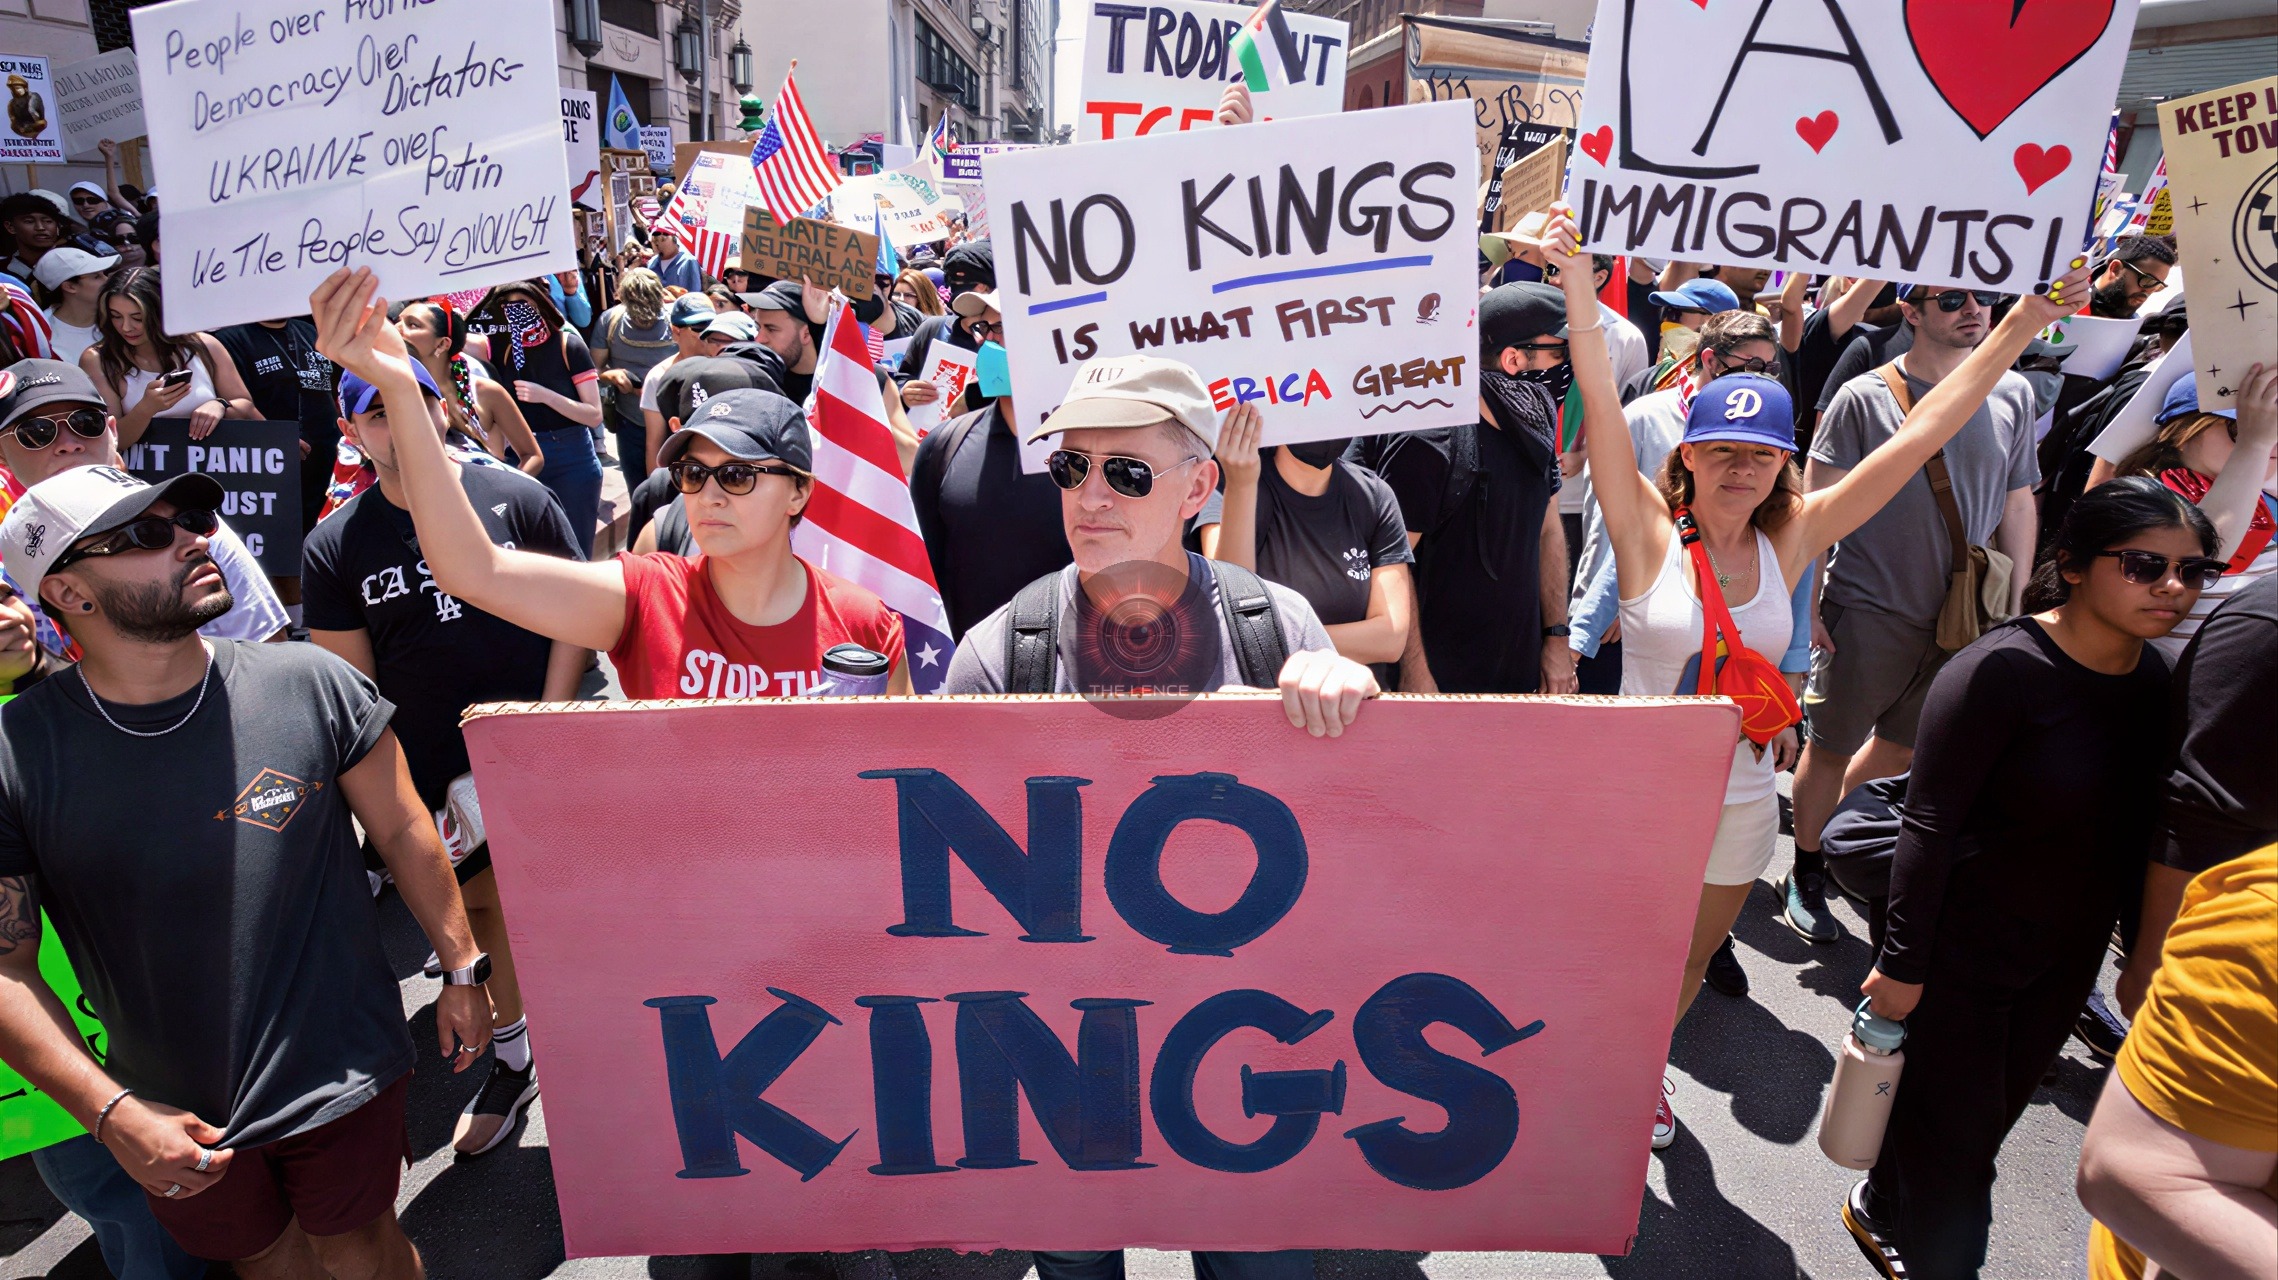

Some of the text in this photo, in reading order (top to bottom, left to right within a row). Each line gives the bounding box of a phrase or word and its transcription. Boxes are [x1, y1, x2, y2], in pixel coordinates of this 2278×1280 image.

[166, 12, 255, 75] People
[270, 10, 325, 43] over
[1094, 3, 1246, 84] TROOP
[2175, 91, 2257, 136] KEEP
[210, 125, 447, 203] UKRAINE over
[298, 209, 389, 268] People
[391, 205, 445, 263] Say
[844, 232, 863, 257] A
[1011, 193, 1136, 296] NO
[1181, 160, 1456, 271] KINGS
[1580, 178, 2063, 295] IMMIGRANTS!
[1052, 296, 1396, 364] IS WHAT FIRST
[1207, 355, 1466, 412] ERICA GREAT
[1724, 388, 1762, 420] D
[187, 445, 285, 475] PANIC
[221, 490, 277, 516] UST
[680, 649, 769, 698] STOP
[858, 767, 1309, 956] NO
[643, 971, 1545, 1191] KINGS
